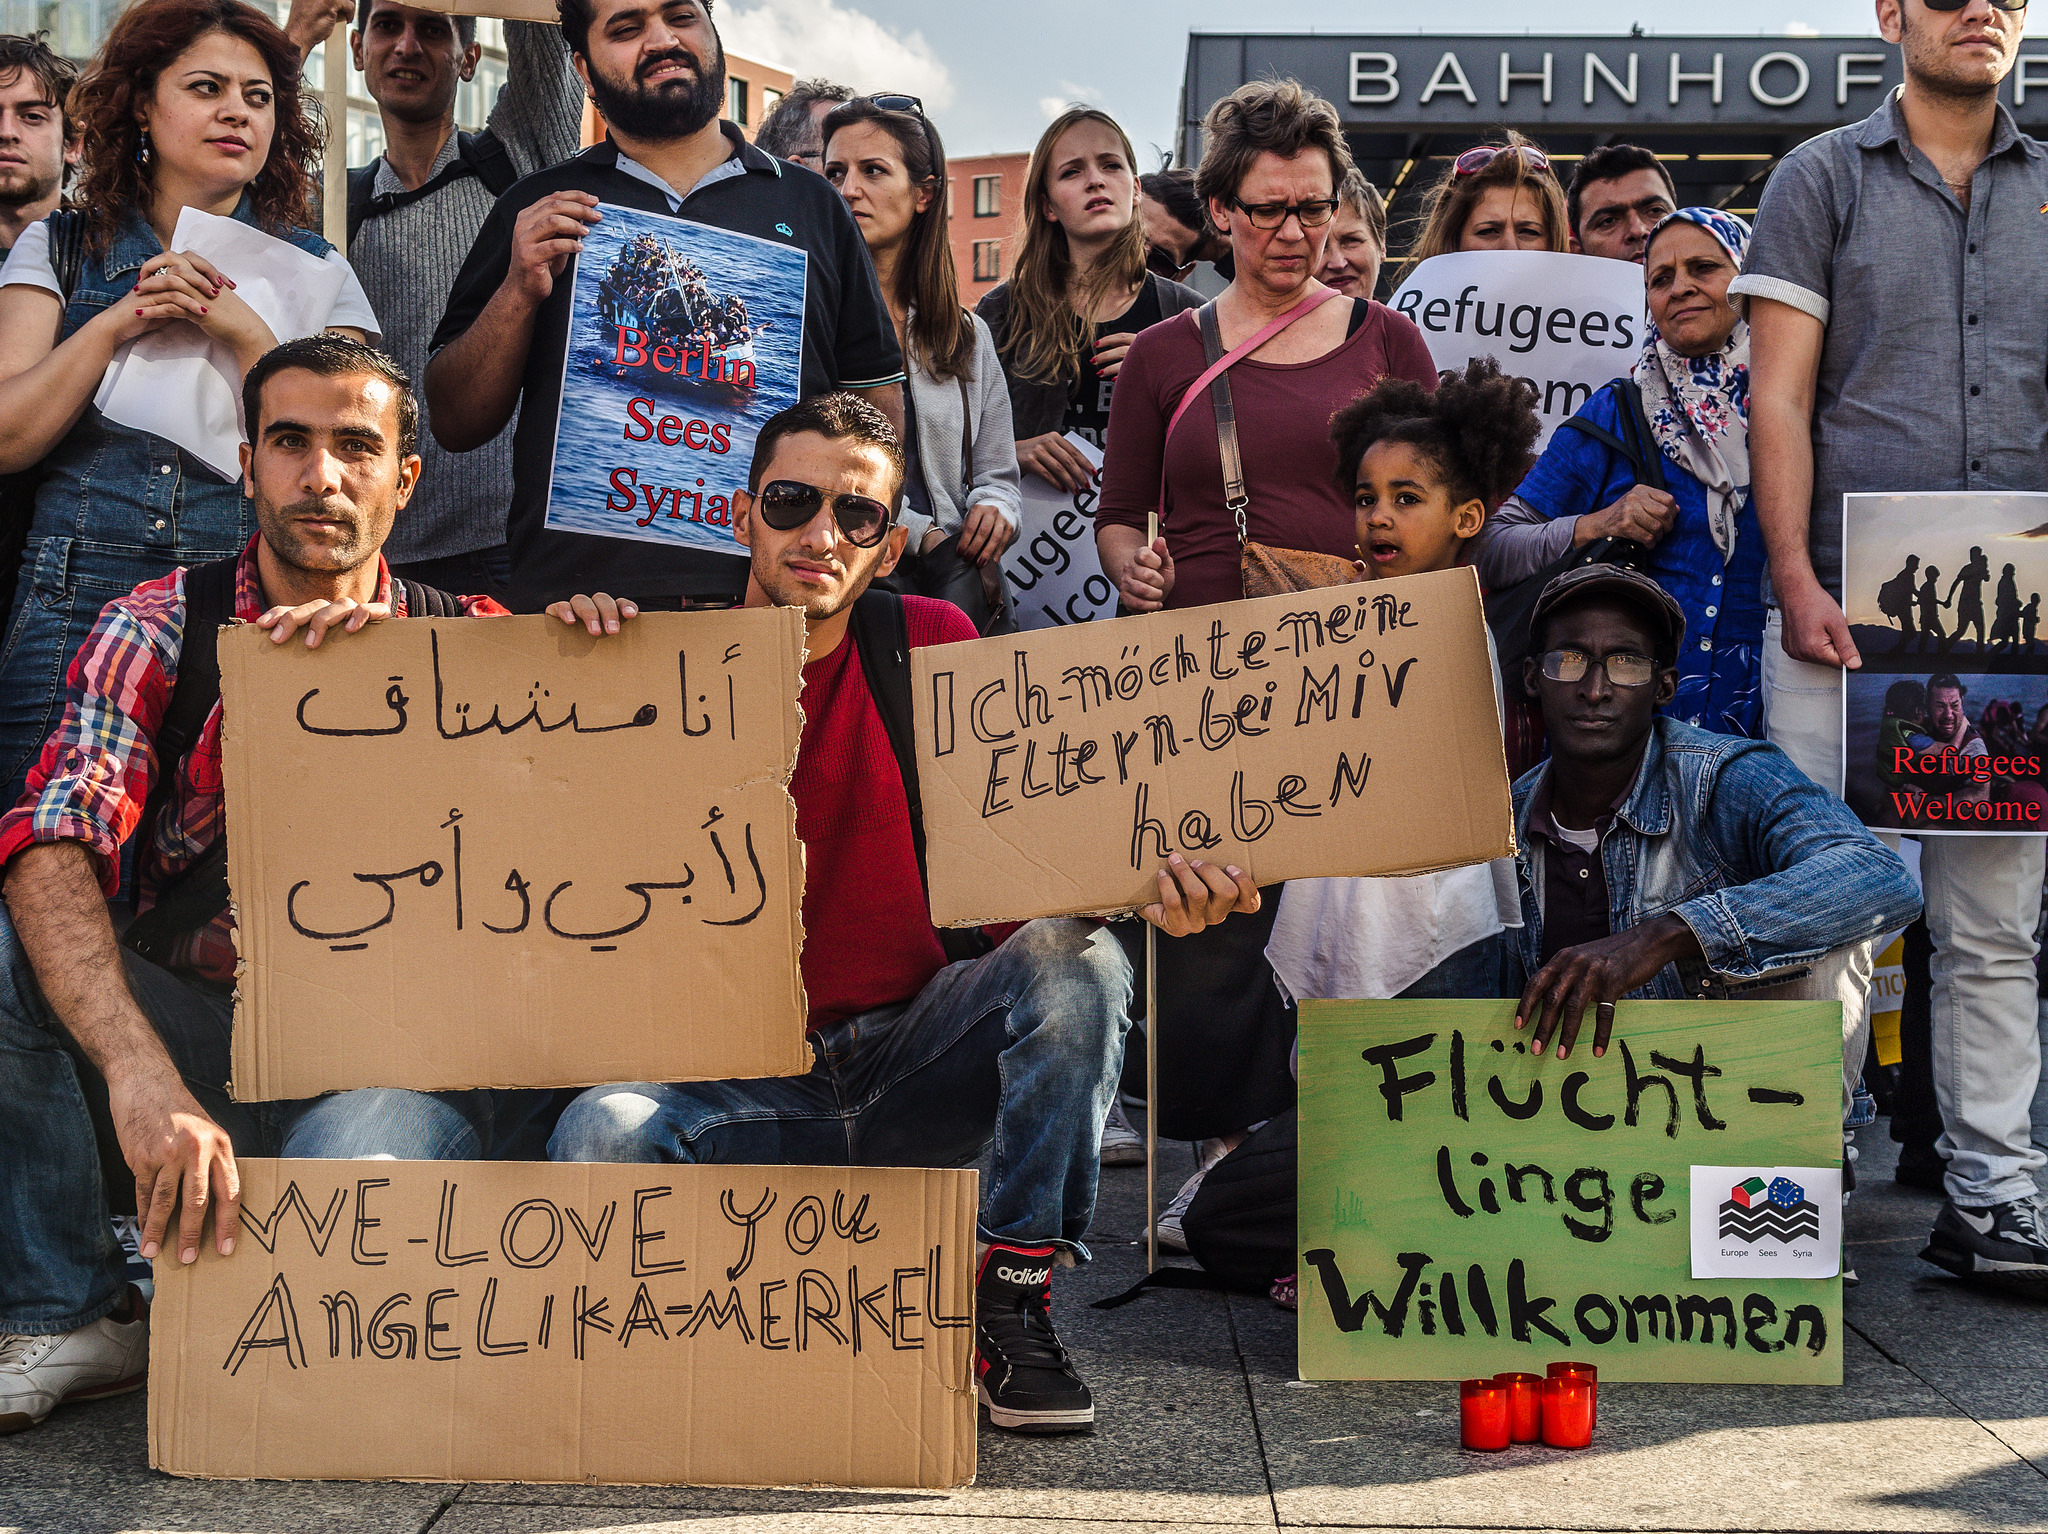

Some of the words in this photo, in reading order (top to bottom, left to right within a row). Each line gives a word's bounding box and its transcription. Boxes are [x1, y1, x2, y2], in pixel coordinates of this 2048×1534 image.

[1348, 51, 1886, 106] BAHNHOF
[1397, 285, 1634, 353] Refugees
[610, 324, 758, 389] Berlin
[624, 398, 731, 454] Sees
[606, 468, 731, 527] Syria
[296, 628, 658, 739] مشتاق
[680, 643, 741, 740] أنا
[1891, 747, 2041, 782] Refugees
[1890, 792, 2041, 822] Welcome
[544, 806, 767, 952] لأبي
[1436, 1145, 1676, 1242] linge
[996, 1266, 1050, 1286] adida
[1721, 1248, 1749, 1258] Europe
[1758, 1248, 1778, 1257] Sees
[1792, 1249, 1813, 1258] Syria
[1302, 1248, 1828, 1357] Willkommen
